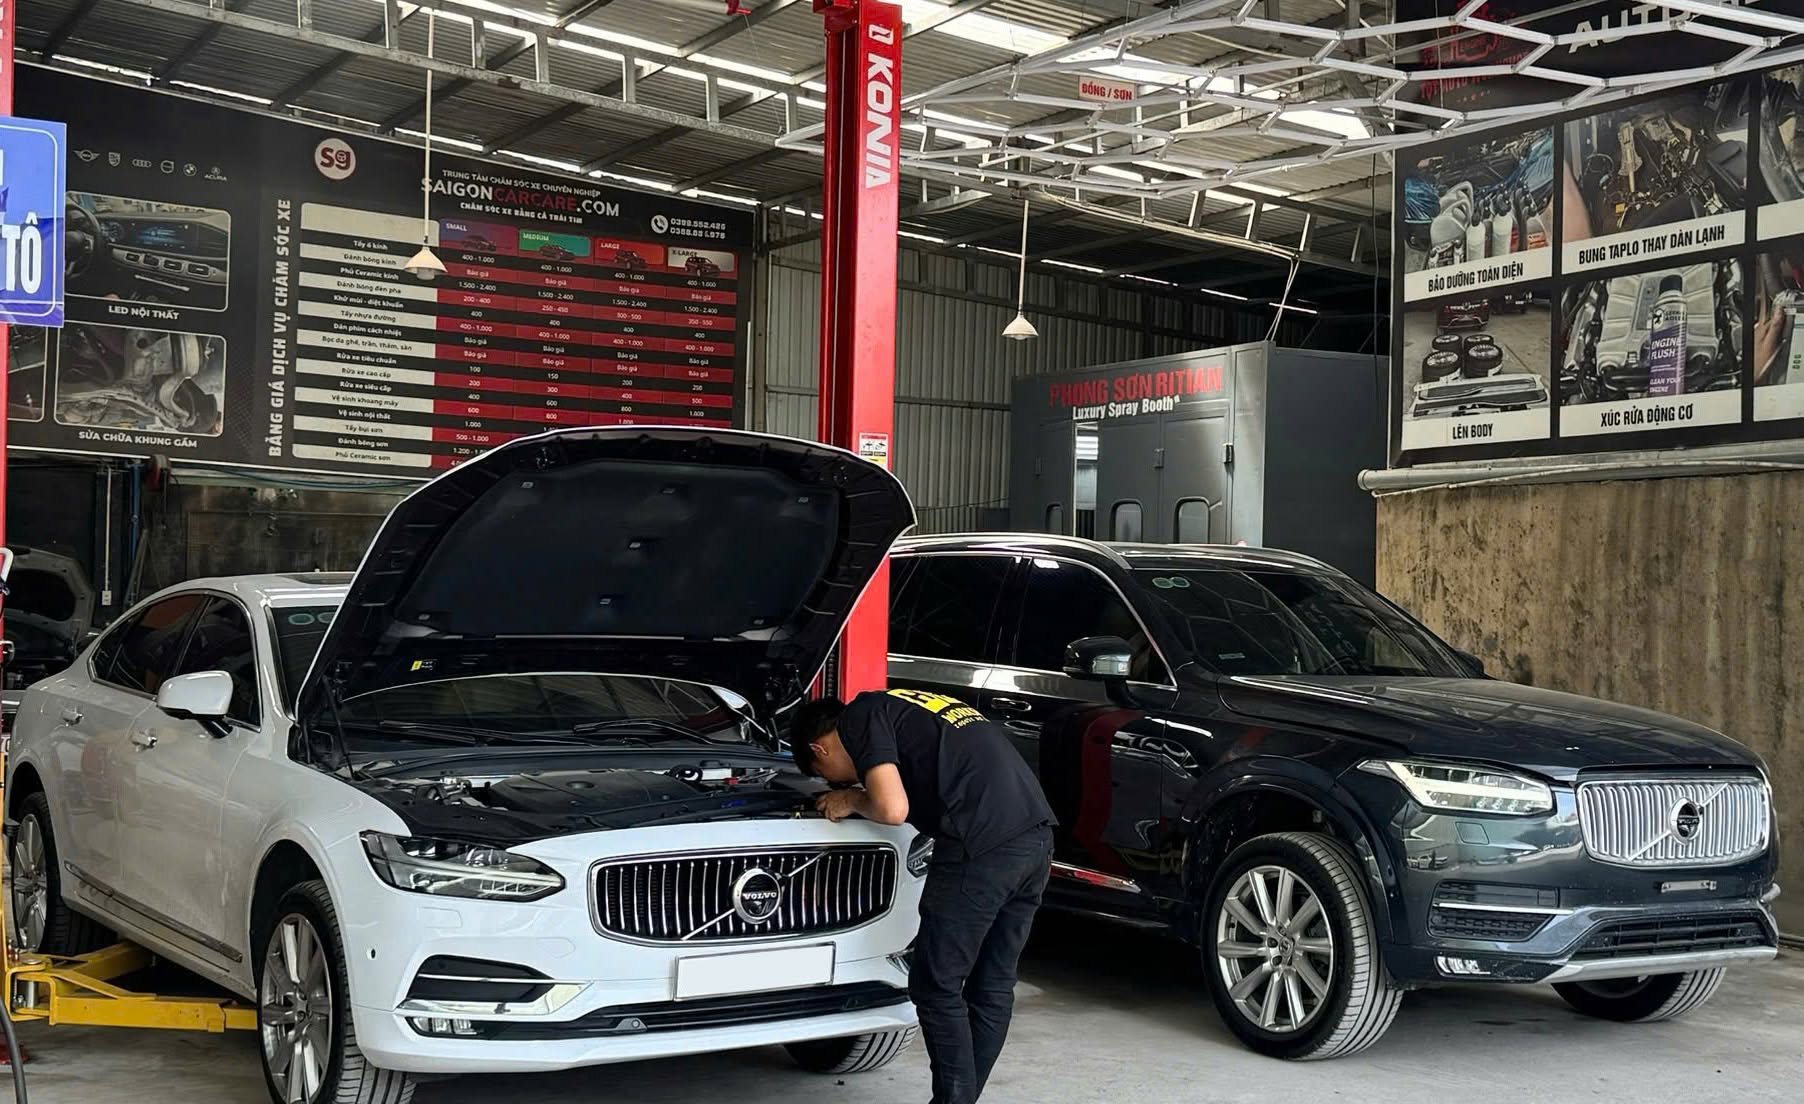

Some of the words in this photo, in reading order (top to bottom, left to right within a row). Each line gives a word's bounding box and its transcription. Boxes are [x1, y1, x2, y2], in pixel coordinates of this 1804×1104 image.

[1113, 88, 1132, 100] SƠN
[865, 52, 894, 189] KONIA
[442, 169, 470, 180] TRUNG
[472, 172, 489, 183] TÂM
[490, 174, 512, 186] CHĂM
[514, 177, 530, 188] SÓC
[531, 181, 541, 190] XE
[542, 182, 572, 194] CHUYÊN
[574, 186, 601, 198] NGHIỆP
[421, 178, 620, 216] SAIGONCARCARE.COM
[278, 199, 291, 221] XE
[460, 202, 483, 212] CHĂM
[484, 204, 500, 214] SÓC
[502, 208, 512, 216] XE
[514, 208, 536, 218] BẰNG
[548, 212, 567, 222] TRÁI
[568, 215, 582, 224] TIM
[446, 222, 468, 232] SMALL
[523, 233, 550, 242] MEDIUM
[274, 225, 290, 256] SÓC
[600, 242, 620, 250] LARGE
[1578, 246, 1606, 265] BUNG
[1609, 241, 1639, 259] TAPLO
[1642, 235, 1668, 253] THAY
[1670, 229, 1692, 249] DÀN
[1696, 224, 1725, 246] LẠNH
[478, 256, 494, 264] 1.000
[272, 260, 290, 307] CHĂM
[355, 269, 382, 278] Ceramic
[1428, 273, 1445, 292] BẢO
[1477, 265, 1500, 284] TOÀN
[1502, 260, 1524, 281] DIỆN
[108, 305, 129, 315] LED
[131, 306, 151, 318] NỘI
[152, 308, 180, 320] THẤT
[274, 312, 291, 333] VỤ
[272, 339, 290, 375] DỊCH
[1155, 366, 1223, 398] RITIAN
[268, 380, 284, 408] GIÁ
[1072, 405, 1106, 421] Luxury
[1108, 402, 1138, 418] Spray
[1600, 408, 1621, 428] XÚC
[1623, 406, 1645, 426] RỬA
[1646, 404, 1676, 426] ĐỘNG
[1678, 402, 1694, 422] CƠ
[78, 429, 100, 440] SỬA
[102, 432, 132, 444] CHỮA
[134, 436, 172, 446] KHUNG
[264, 412, 284, 457] BẢNG
[1452, 420, 1469, 440] LÊN
[1470, 423, 1494, 440] BODY
[350, 452, 378, 460] Ceramic
[742, 892, 777, 900] VOLVO
